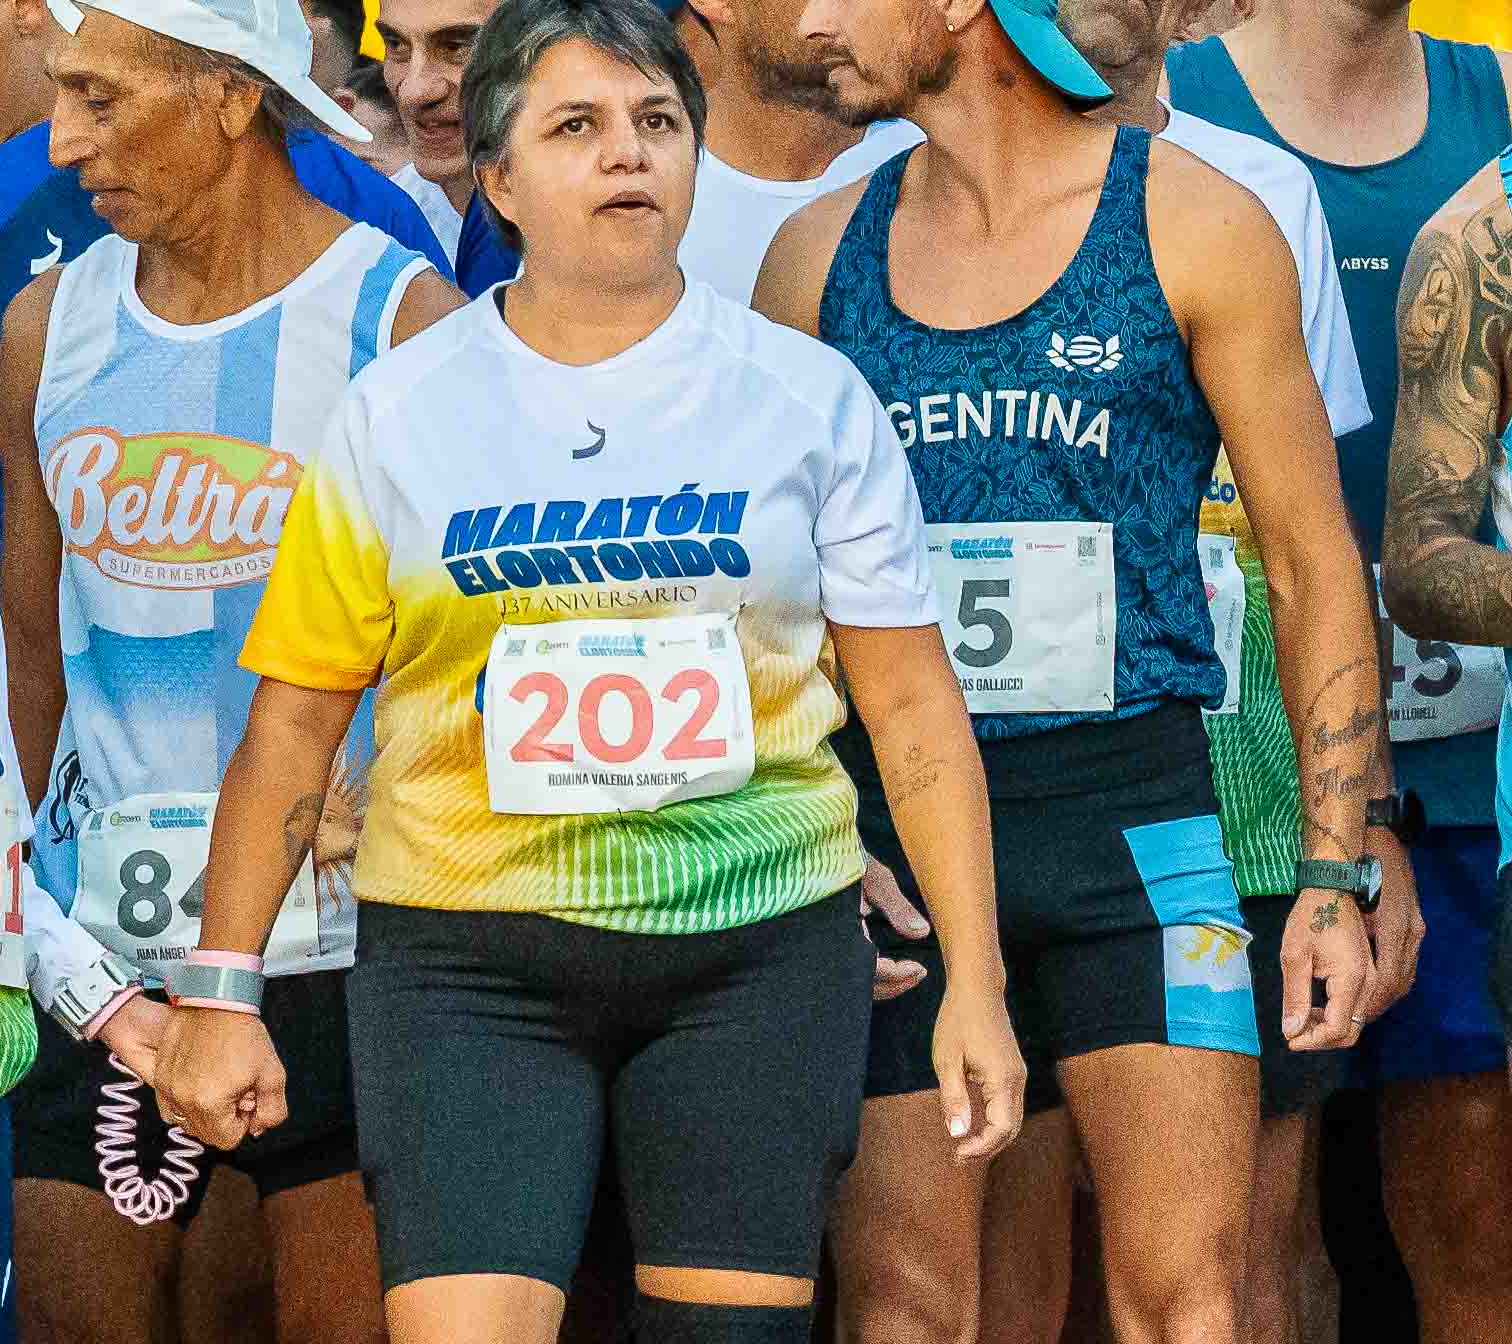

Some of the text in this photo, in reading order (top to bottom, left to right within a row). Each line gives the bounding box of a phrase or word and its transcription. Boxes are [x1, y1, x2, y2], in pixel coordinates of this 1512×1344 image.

[1340, 257, 1390, 271] ABYSS
[887, 389, 1110, 457] GENTINA
[46, 433, 298, 545] Beltrá
[441, 482, 749, 559] MARATÓN
[109, 558, 272, 583] SUPERMERCADOS
[444, 537, 752, 597] ELORTONDO
[502, 585, 698, 617] 137 ANIVERSARIO
[953, 579, 1013, 668] 5
[976, 678, 1023, 692] GALLUCCI
[508, 668, 727, 763] 202
[548, 771, 688, 787] ROMINA VALERIA SANGENIS
